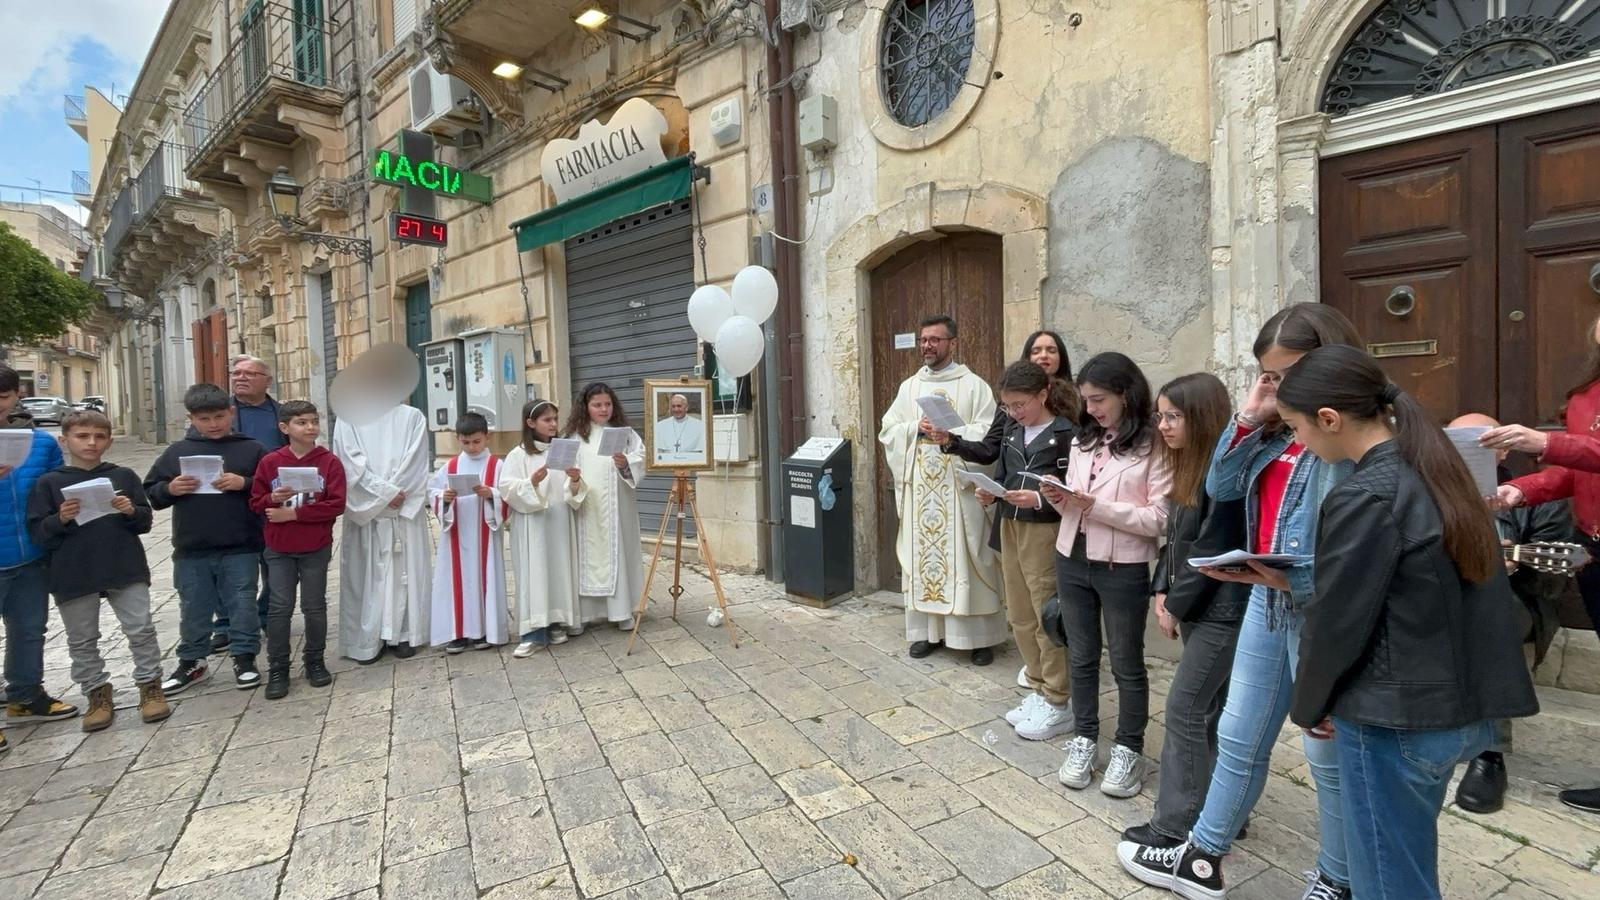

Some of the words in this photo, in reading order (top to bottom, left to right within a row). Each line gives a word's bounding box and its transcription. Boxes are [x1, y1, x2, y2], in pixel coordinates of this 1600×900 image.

[555, 124, 645, 185] FARMACIA
[398, 219, 420, 238] 27
[432, 225, 444, 241] 4
[788, 470, 813, 478] RACCOLTA
